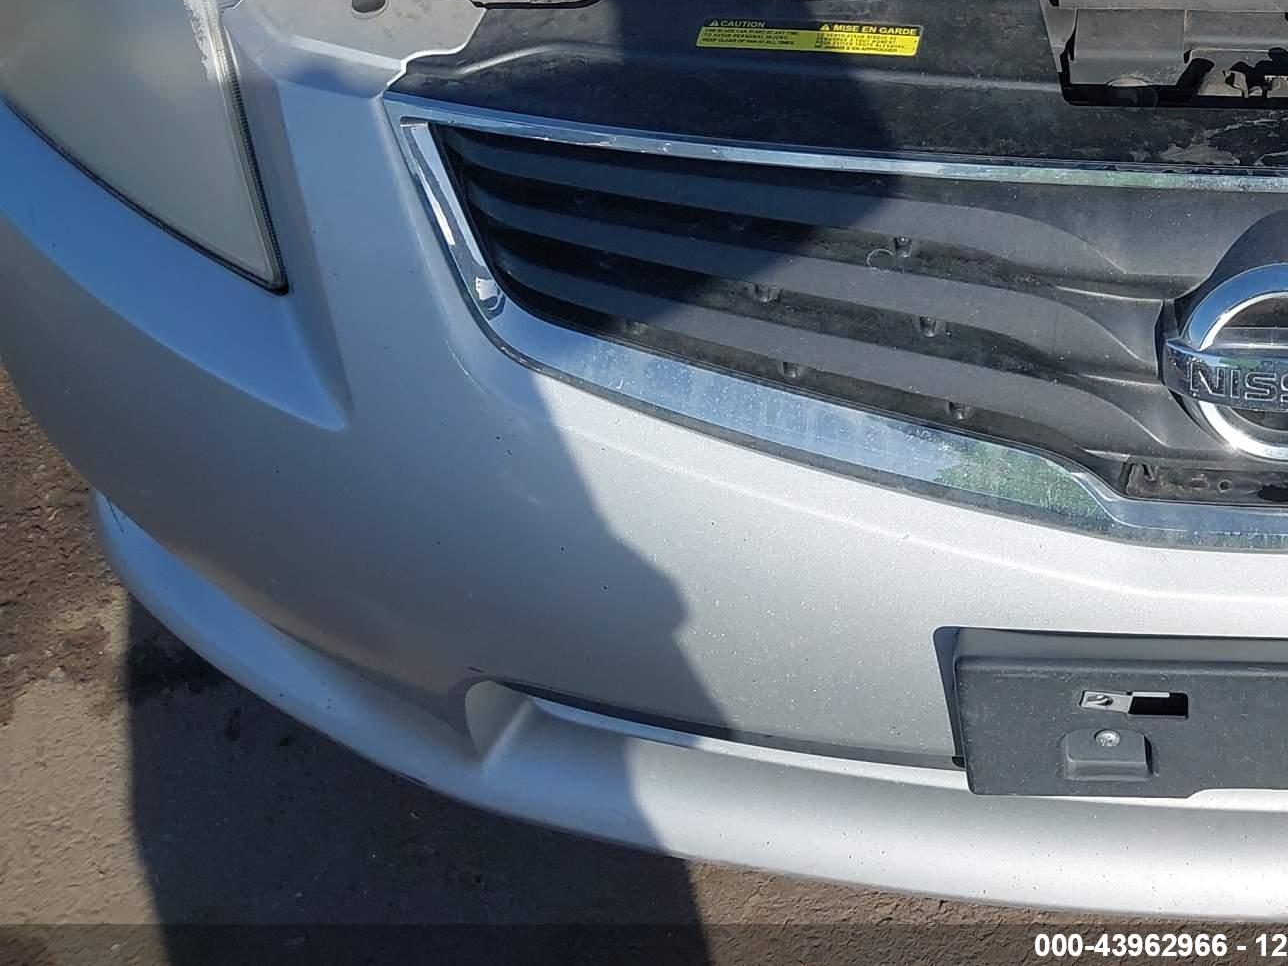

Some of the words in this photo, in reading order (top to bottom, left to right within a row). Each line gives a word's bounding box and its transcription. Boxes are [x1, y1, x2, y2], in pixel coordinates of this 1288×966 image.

[720, 20, 766, 28] CAUTION
[833, 24, 860, 32] MISE
[861, 25, 877, 33] EN
[879, 26, 918, 35] GARDE
